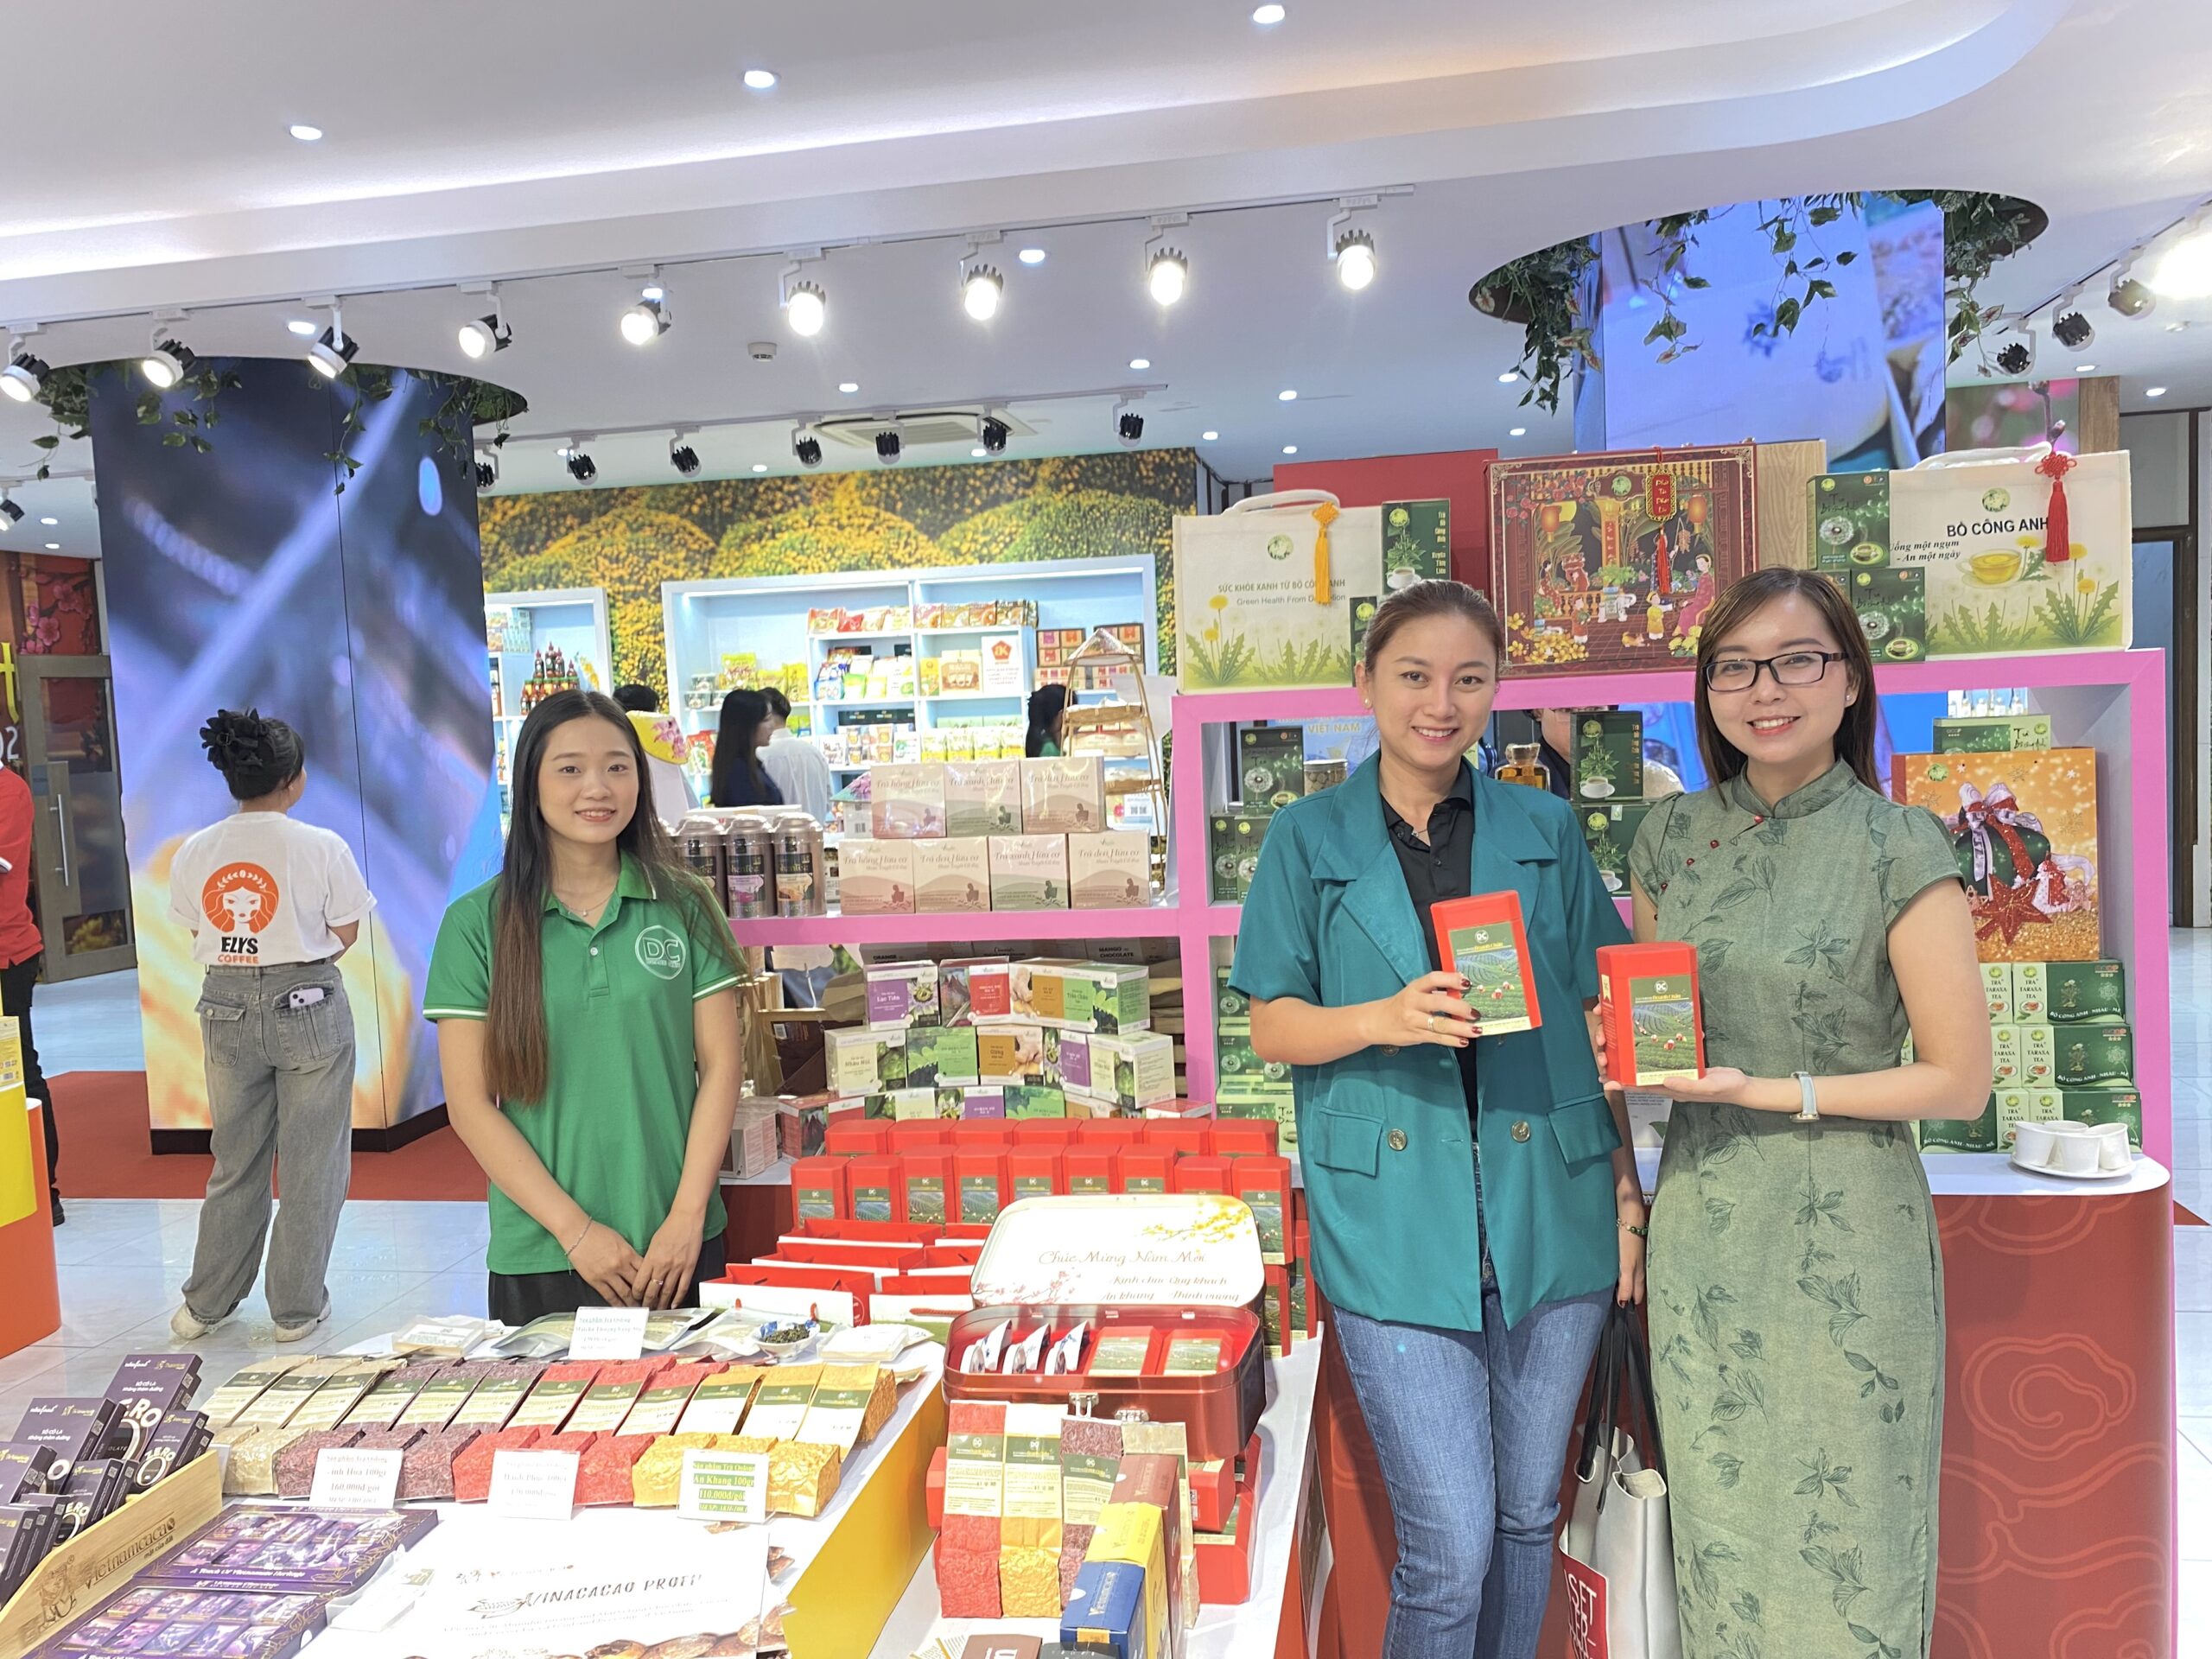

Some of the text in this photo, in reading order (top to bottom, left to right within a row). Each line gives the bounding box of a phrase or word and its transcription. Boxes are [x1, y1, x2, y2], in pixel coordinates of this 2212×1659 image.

[1972, 518, 2015, 535] CÔNG
[2018, 517, 2049, 531] ANH
[1256, 582, 1278, 591] XANH
[1262, 596, 1285, 605] Health
[221, 936, 258, 955] ELYS
[642, 937, 681, 963] DC
[217, 955, 259, 964] COFFEE
[1656, 982, 1668, 992] DC
[143, 1446, 176, 1461] ZERO
[694, 1474, 754, 1486] An Khang 100gr
[65, 1502, 90, 1516] ERO
